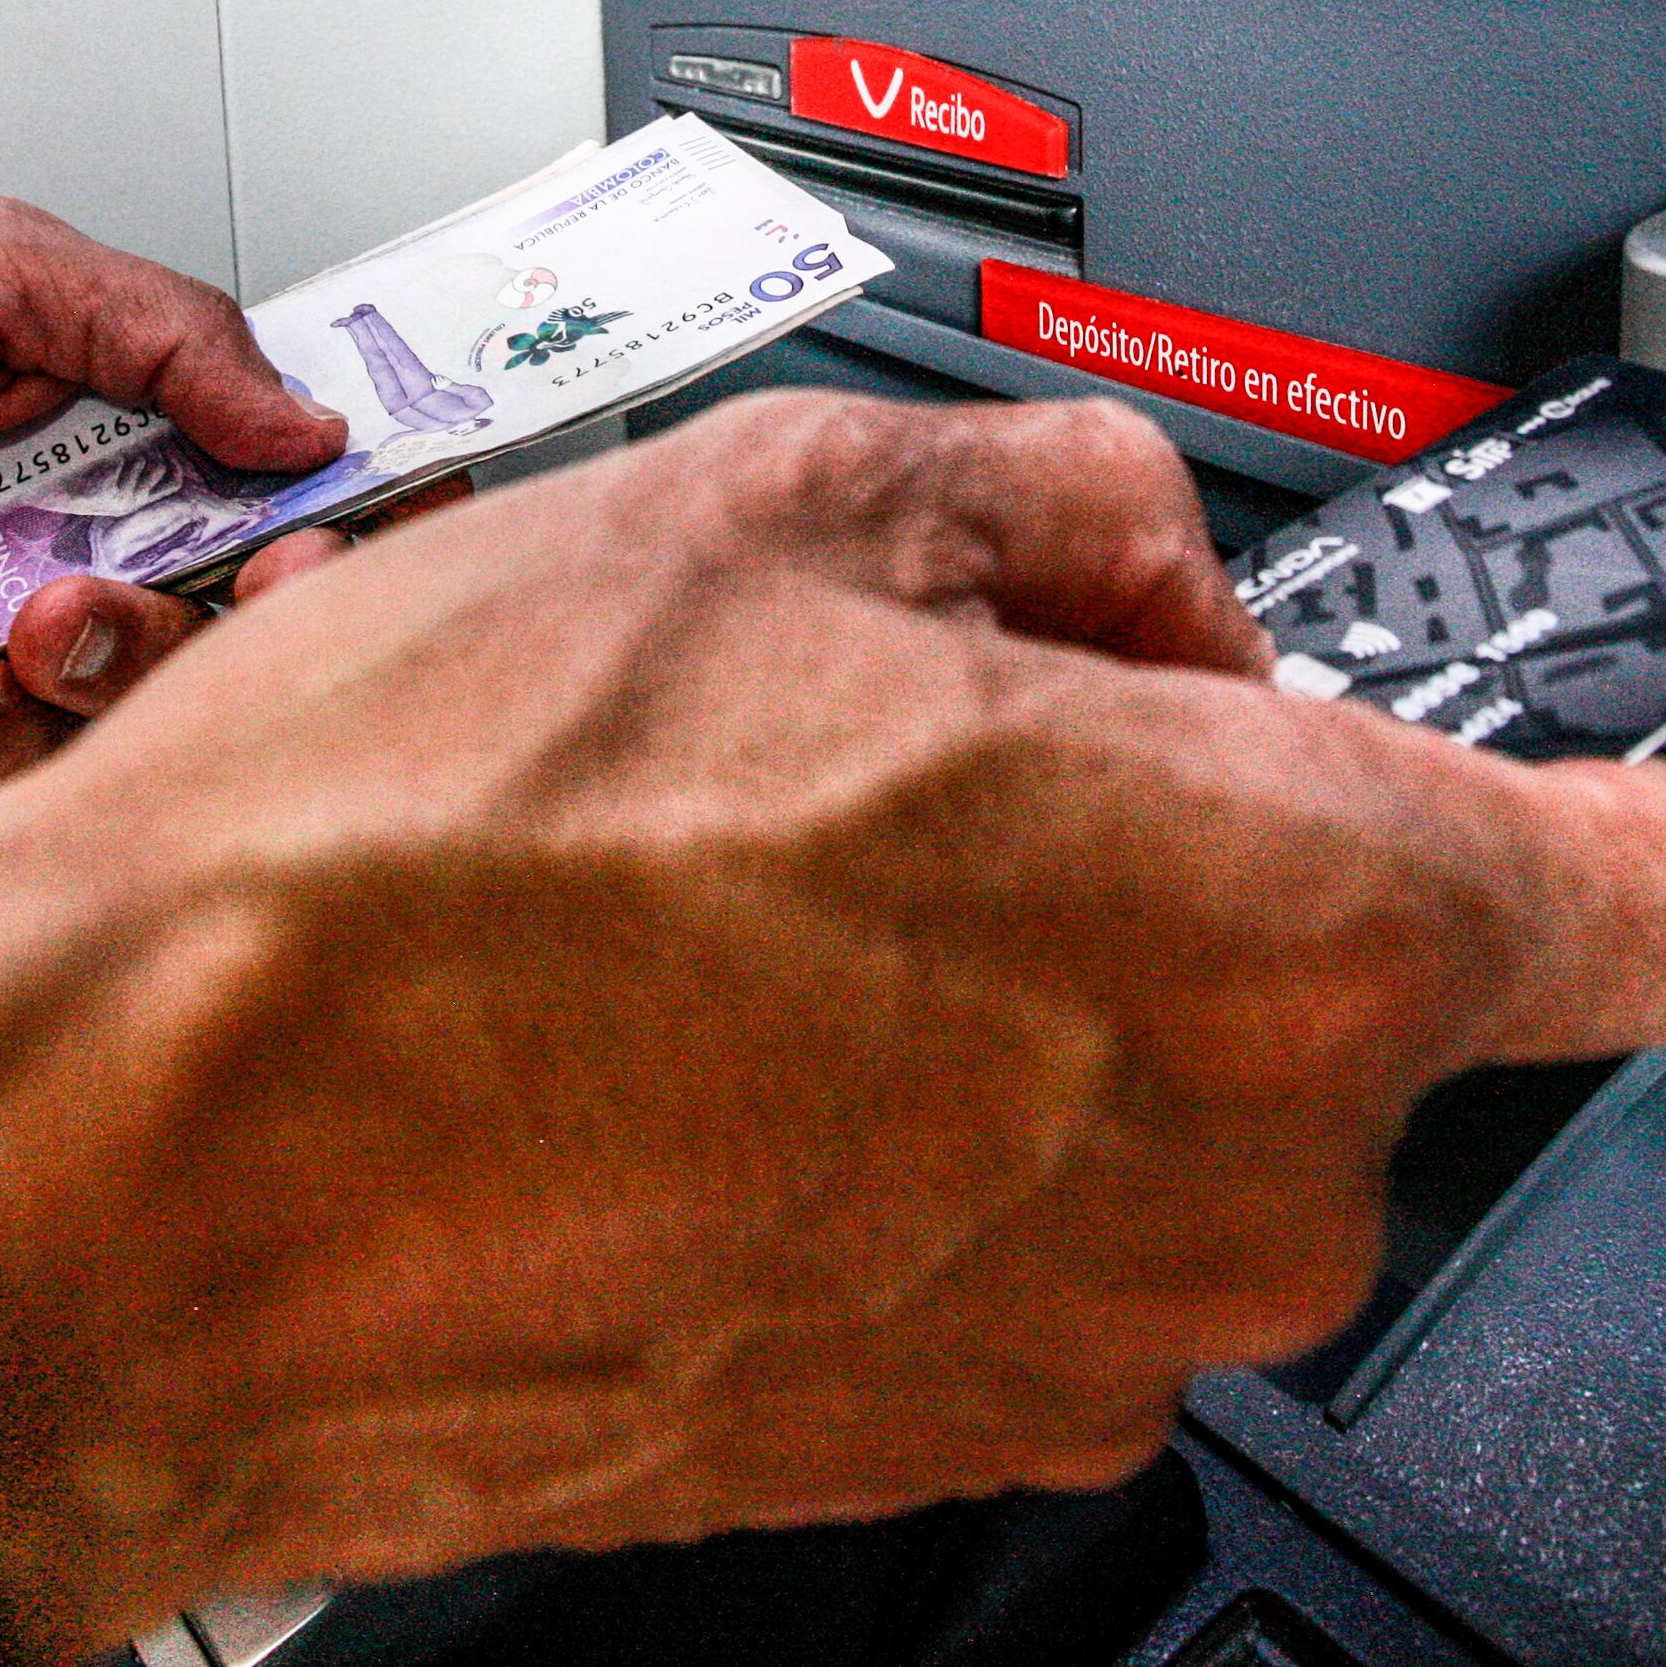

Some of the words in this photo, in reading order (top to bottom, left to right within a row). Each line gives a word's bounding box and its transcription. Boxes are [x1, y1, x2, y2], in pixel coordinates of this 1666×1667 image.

[909, 85, 987, 143] Recibo
[567, 147, 672, 209] COLOMBIA
[631, 157, 681, 190] BANCO
[513, 211, 588, 252] REPÚBLICA
[749, 242, 844, 303] 50
[550, 291, 734, 388] BC92185773
[697, 301, 754, 332] PESOS
[733, 306, 763, 325] MIL
[1036, 301, 1237, 394] Depósito/Retiro
[1244, 367, 1278, 405] en
[1286, 372, 1407, 441] efectivo
